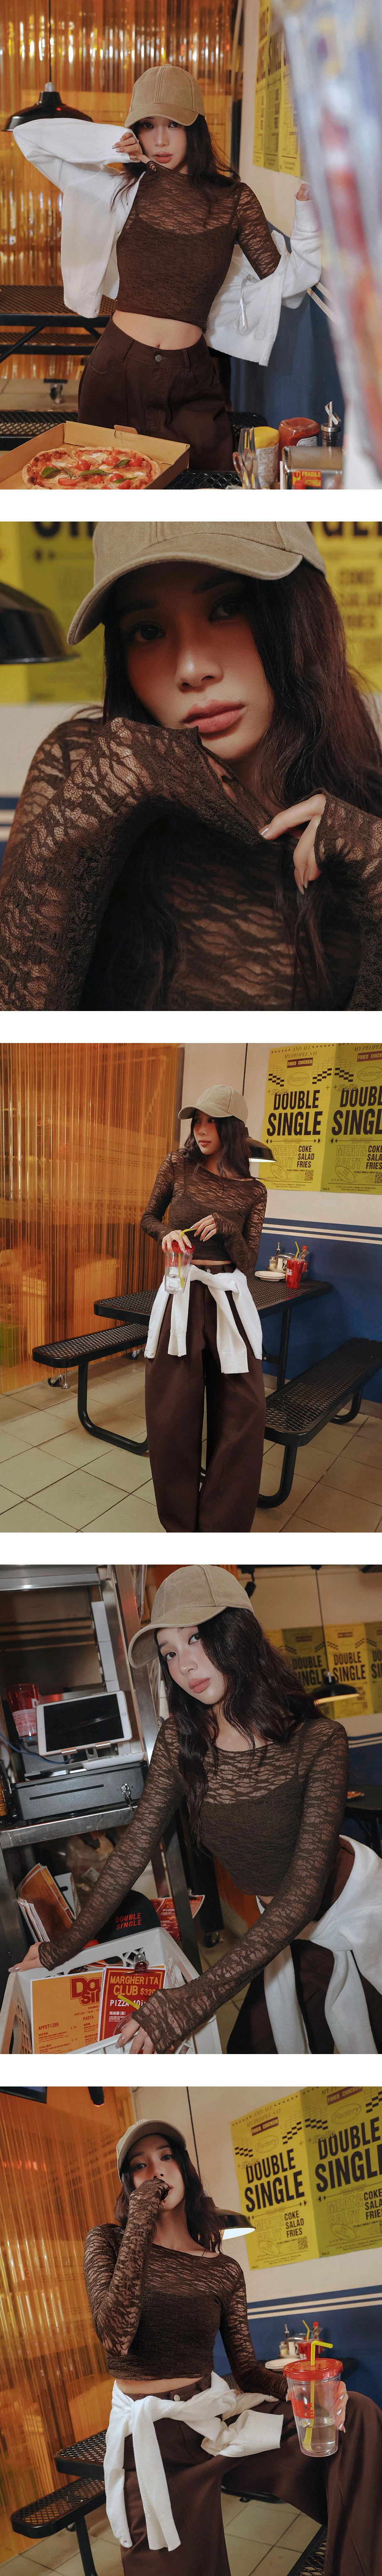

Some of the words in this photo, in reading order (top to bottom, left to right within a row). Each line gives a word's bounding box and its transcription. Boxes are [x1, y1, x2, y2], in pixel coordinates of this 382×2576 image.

[273, 1090, 320, 1110] DOUBLE
[267, 1111, 323, 1137] SINGLE
[332, 1108, 382, 1135] SINGL
[292, 1655, 322, 1670] DOUBLE
[333, 1651, 362, 1666] DOUBLE
[372, 1648, 382, 1662] DO
[298, 1668, 326, 1686] INGLE
[333, 1665, 366, 1682] SINGLE
[371, 1663, 382, 1678] SI
[115, 1912, 141, 1923] DOUBLE
[116, 1919, 142, 1930] SINGLE
[110, 1976, 159, 1985] MARGHERITA
[113, 1985, 138, 1996] CLUB
[38, 2022, 59, 2030] APPETIZER
[328, 2094, 340, 2103] FRIED
[342, 2086, 362, 2097] CHICKEN
[333, 2106, 360, 2121] Factory
[318, 2116, 381, 2160] DOUBLE
[246, 2148, 296, 2184] DOUBLE
[245, 2170, 305, 2212] SINGLE
[364, 2188, 382, 2201] COKE
[284, 2210, 299, 2221] COKE
[285, 2218, 304, 2229] SALAD
[286, 2228, 303, 2238] FRIES
